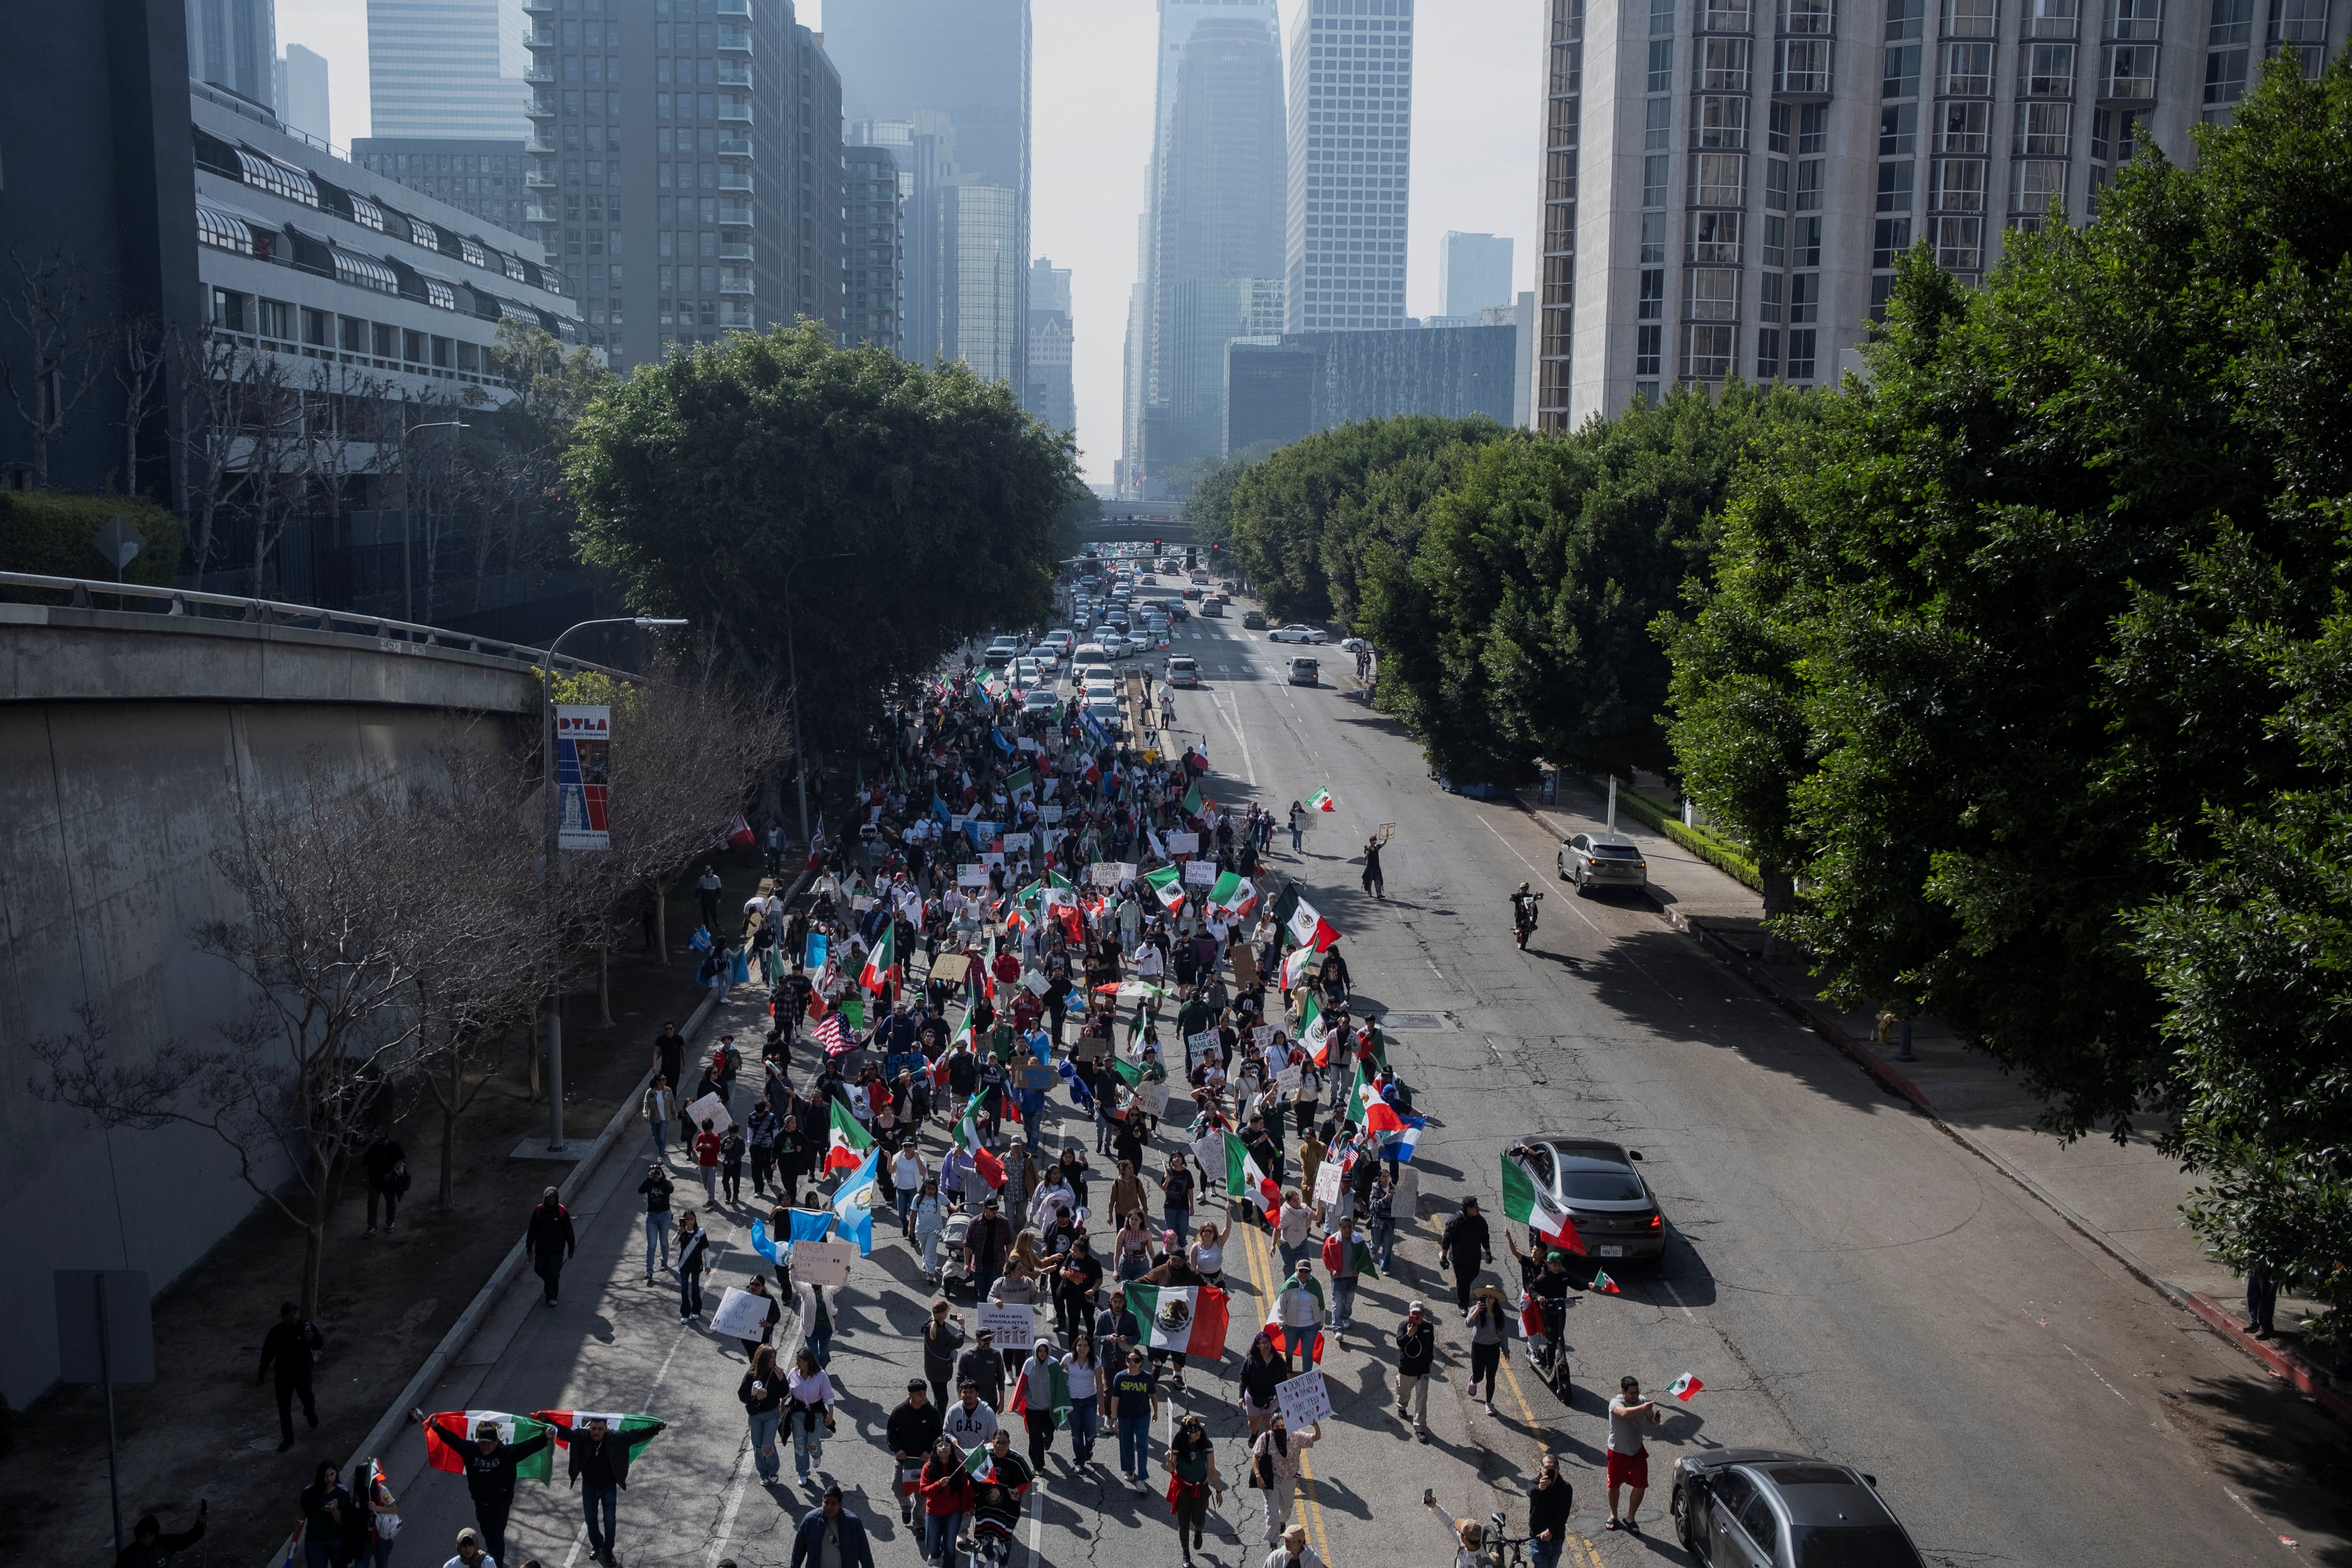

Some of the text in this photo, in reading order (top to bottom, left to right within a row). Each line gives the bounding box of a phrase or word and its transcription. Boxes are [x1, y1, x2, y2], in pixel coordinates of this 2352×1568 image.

[559, 718, 607, 730] DTLA
[1186, 869, 1207, 879] Padres
[1194, 1033, 1211, 1042] KEEP
[1190, 1038, 1219, 1051] FAMILIES
[887, 1051, 922, 1065] NO ONE
[1127, 1055, 1140, 1064] YOU
[887, 1064, 896, 1074] IS
[1280, 1082, 1302, 1092] ATTENTION
[1150, 1094, 1160, 1103] mis
[795, 1242, 825, 1253] MAGA
[794, 1252, 828, 1263] Mexicans
[794, 1274, 830, 1284] Anywhere!
[733, 1310, 744, 1321] Nos
[723, 1319, 746, 1332] Vamos!
[1120, 1381, 1148, 1393] SPAM
[1288, 1375, 1318, 1392] DON'T BITE
[1284, 1386, 1315, 1404] THE HANDS
[1293, 1396, 1320, 1413] THAT FEED
[1303, 1408, 1315, 1418] YOU
[956, 1419, 983, 1433] GAP
